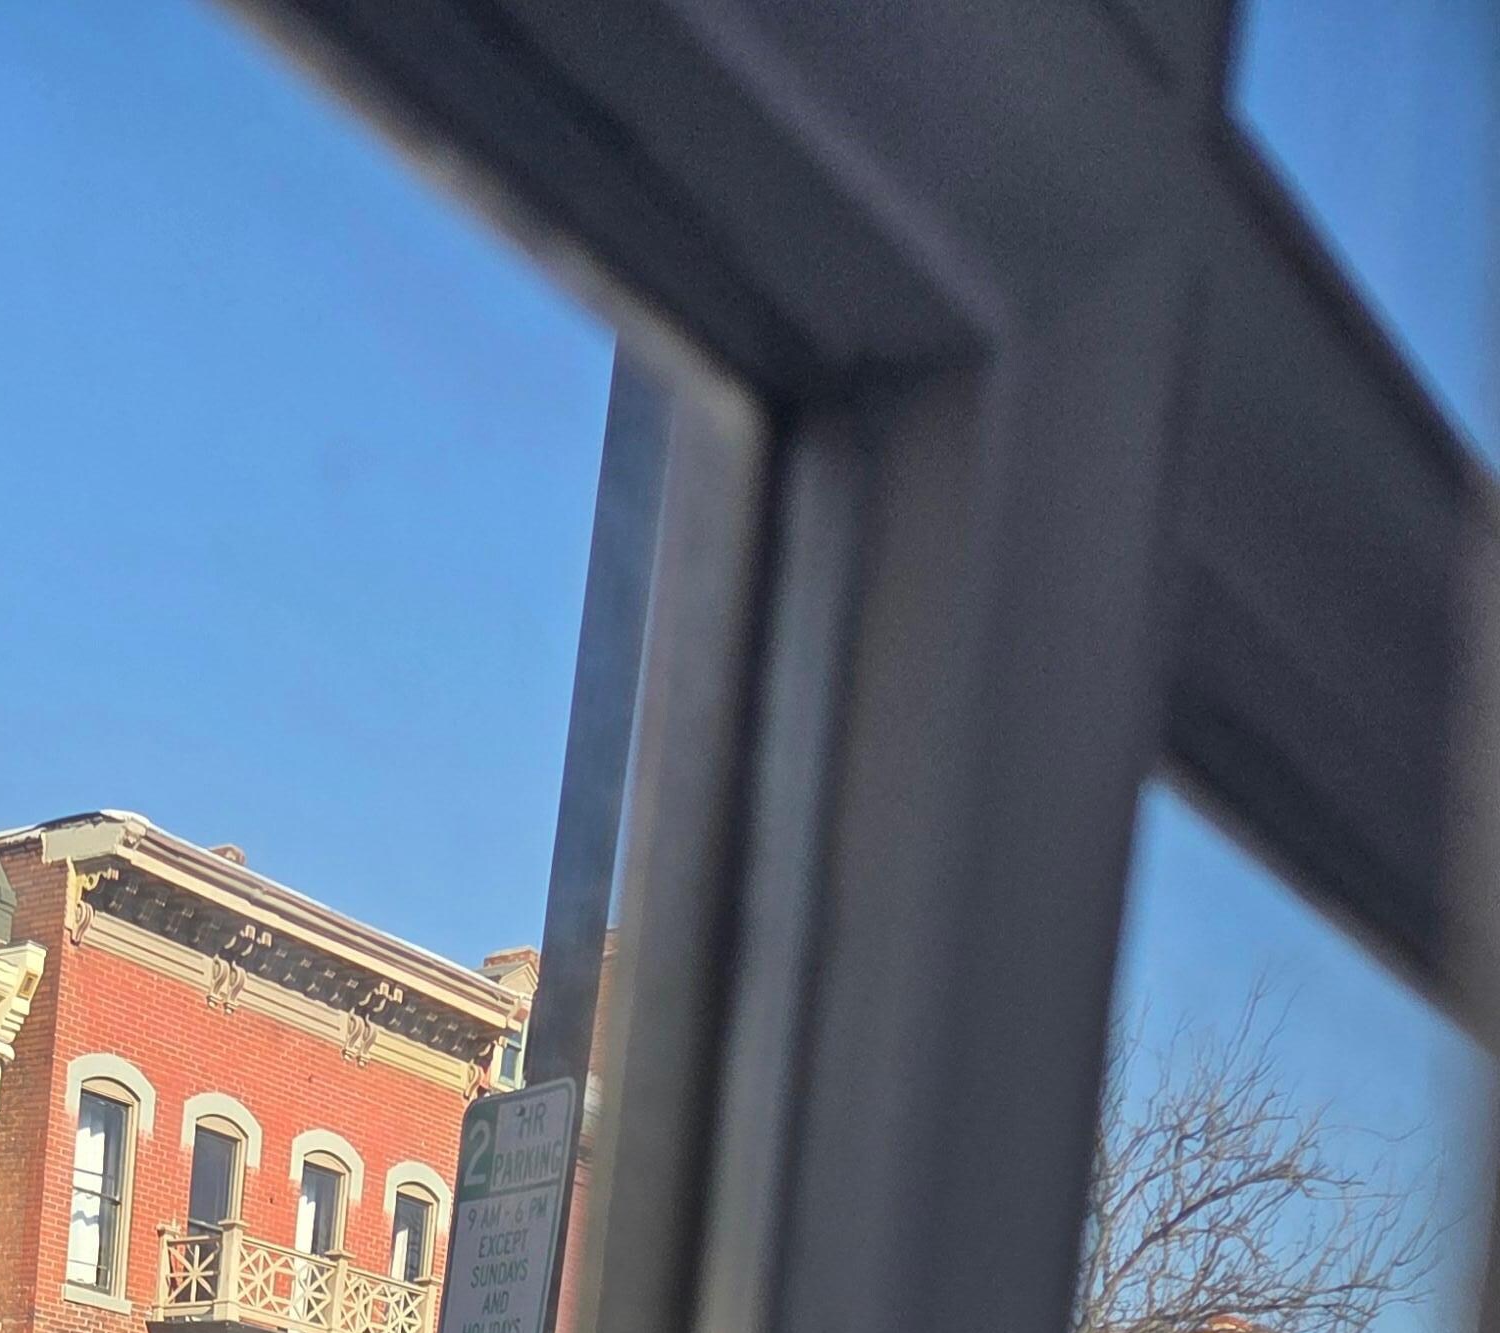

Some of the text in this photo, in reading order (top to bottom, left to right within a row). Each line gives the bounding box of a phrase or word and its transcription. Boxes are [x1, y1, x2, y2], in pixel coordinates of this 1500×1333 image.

[464, 1102, 547, 1187] 2 HR
[492, 1139, 564, 1188] PARKING
[467, 1208, 478, 1231] 9
[480, 1203, 502, 1229] AM
[514, 1199, 525, 1223] 6
[528, 1194, 549, 1220] PM
[477, 1228, 529, 1259] EXCEPT
[470, 1257, 529, 1289] SUNDAYS
[481, 1290, 510, 1315] AND
